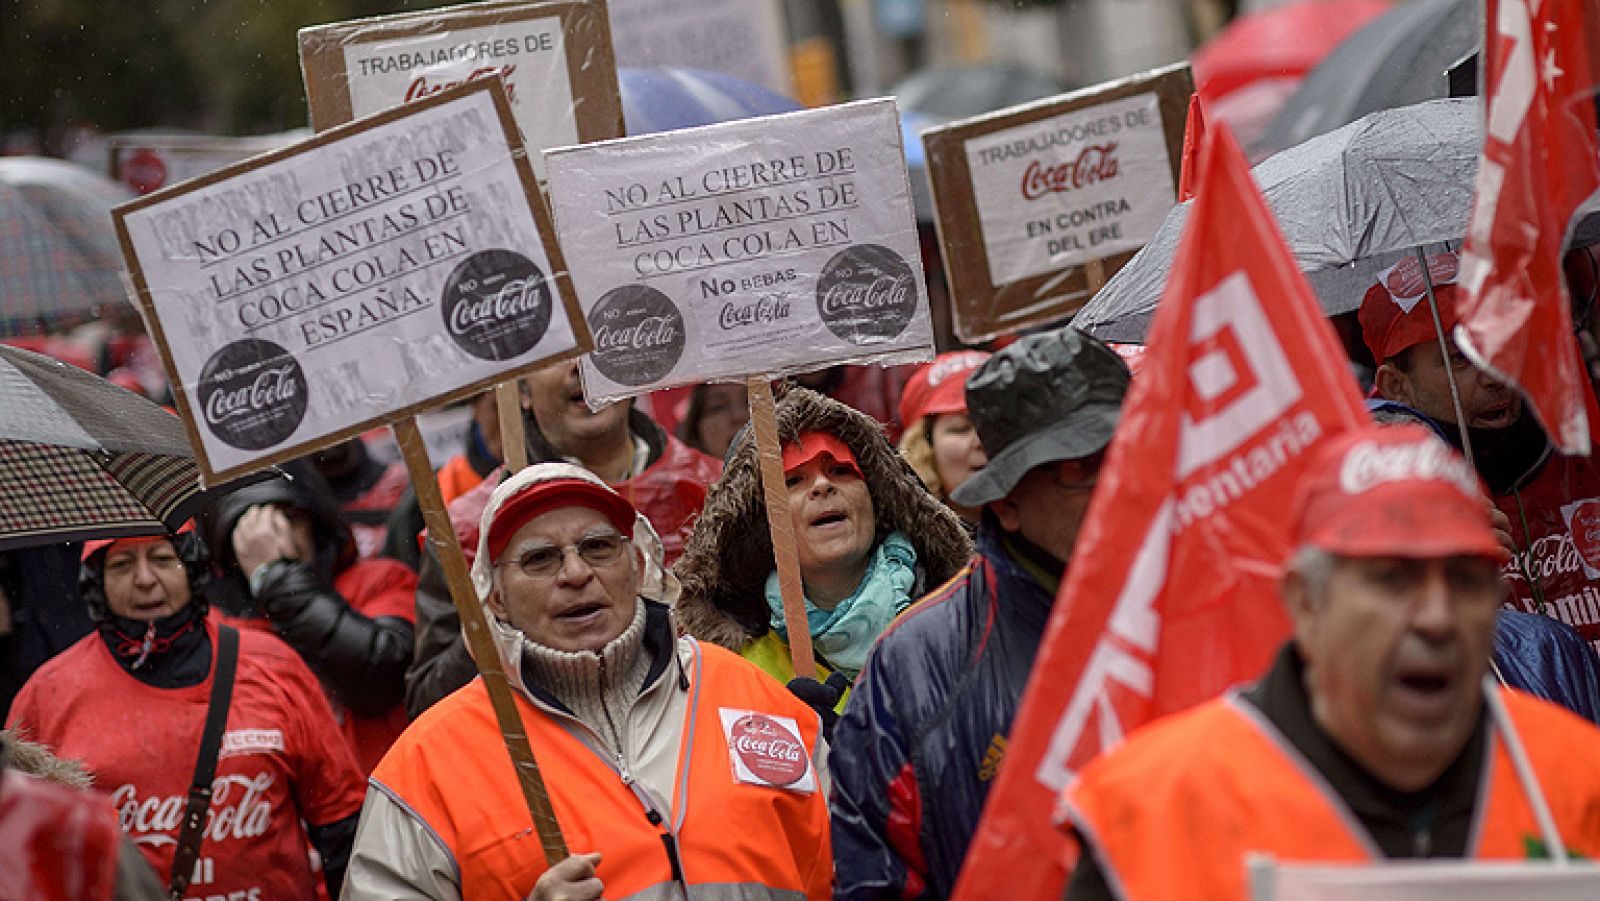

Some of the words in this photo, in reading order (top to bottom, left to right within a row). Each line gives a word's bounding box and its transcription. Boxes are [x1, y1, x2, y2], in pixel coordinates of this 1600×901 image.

[524, 33, 553, 53] DE
[978, 114, 1122, 166] TRABAJADORES
[1125, 107, 1149, 128] DE
[193, 228, 241, 263] NO
[251, 212, 291, 244] AL
[297, 166, 409, 224] CIERRE
[415, 150, 459, 182] DE
[604, 183, 648, 211] NO
[658, 176, 697, 201] AL
[703, 156, 809, 192] CIERRE
[815, 147, 856, 174] DE
[210, 257, 271, 298] LAS
[277, 204, 419, 274] PLANTAS
[424, 186, 469, 220] DE
[615, 215, 670, 244] LAS
[677, 190, 811, 233] PLANTAS
[818, 182, 858, 209] DE
[1026, 217, 1052, 239] EN
[1056, 198, 1131, 229] CONTRA
[1047, 237, 1083, 255] DEL
[1085, 223, 1122, 246] ERE
[634, 243, 715, 275] COCA
[723, 228, 804, 259] COLA
[812, 218, 850, 244] EN
[238, 280, 326, 328] COCA
[332, 247, 418, 293] COLA
[424, 225, 467, 259] EN
[300, 286, 431, 345] ESPAÑA.
